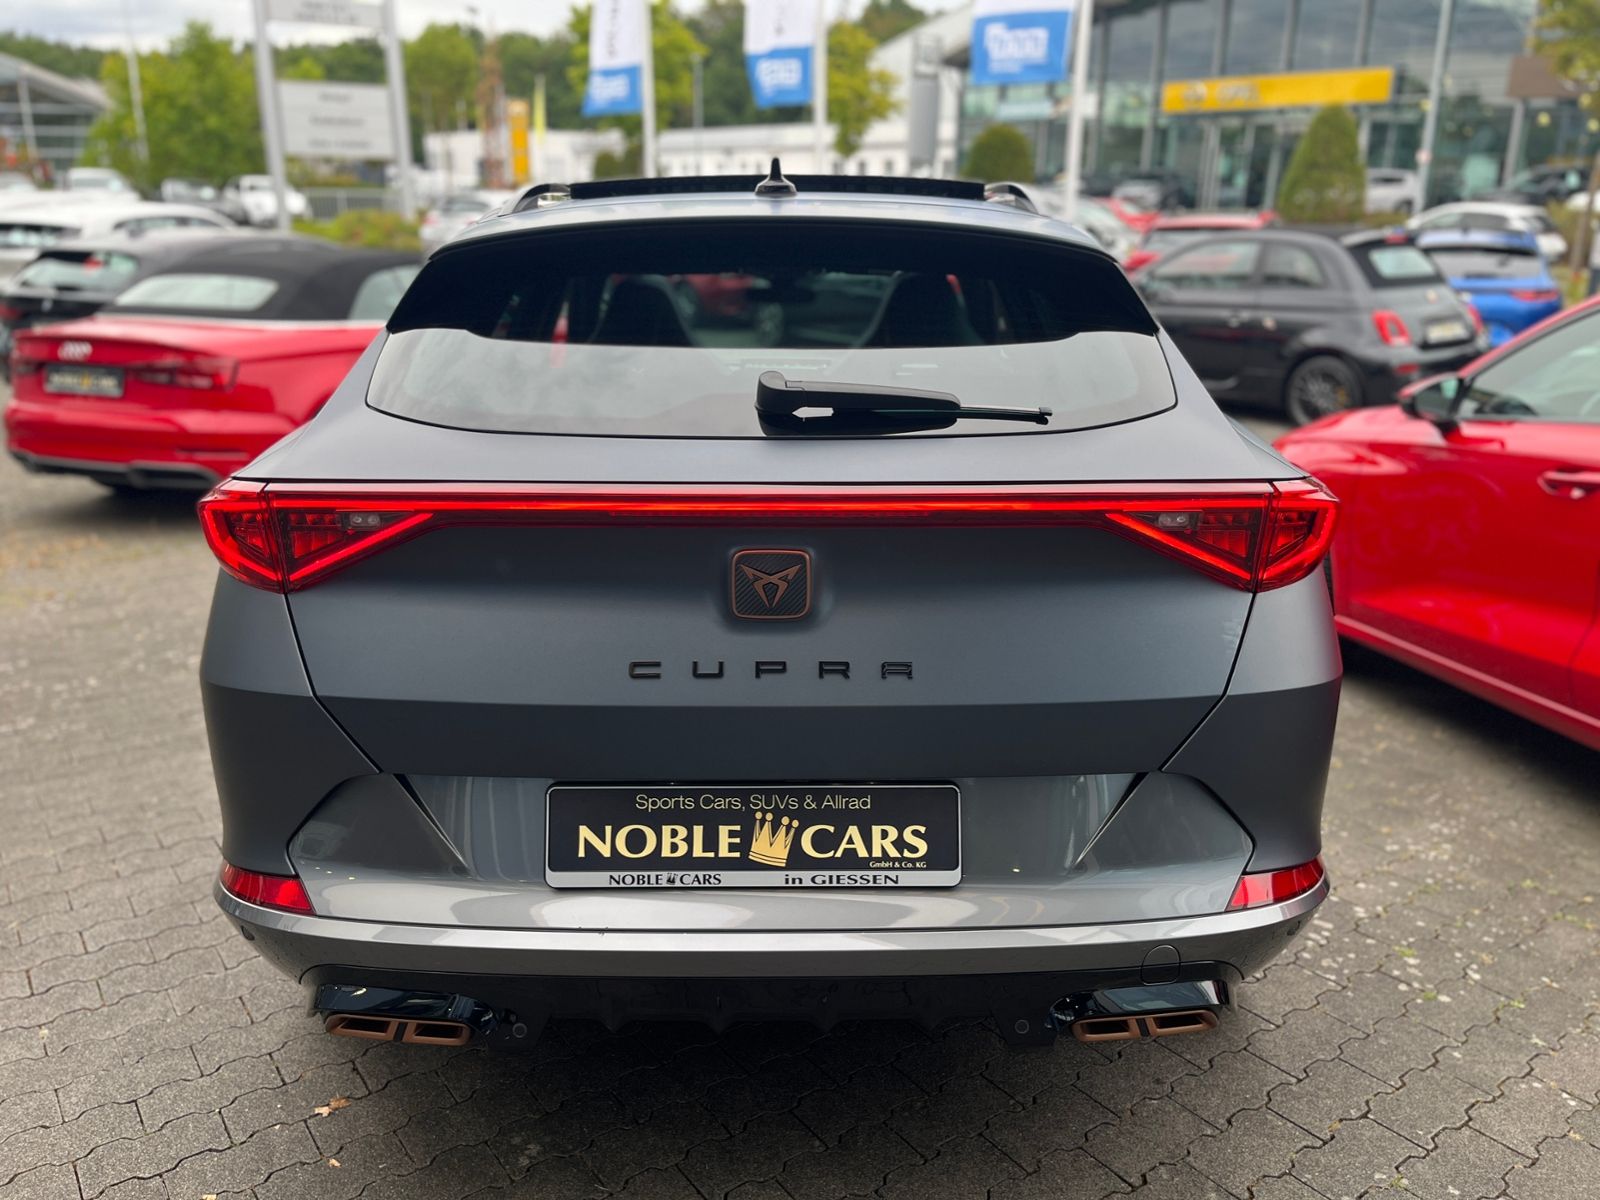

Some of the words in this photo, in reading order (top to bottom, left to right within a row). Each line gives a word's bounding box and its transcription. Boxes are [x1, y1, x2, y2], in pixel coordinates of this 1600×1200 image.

[629, 661, 912, 679] CUPRA
[635, 794, 695, 811] Sports
[700, 794, 745, 811] Cars,
[750, 795, 799, 809] SUVs
[804, 795, 818, 809] &
[821, 794, 871, 809] Allrad
[577, 825, 741, 858] NOBLE
[800, 824, 928, 858] CARS
[609, 874, 663, 885] NOBLE
[680, 874, 722, 885] CARS
[785, 874, 803, 885] in
[811, 874, 899, 885] GIESSEN
